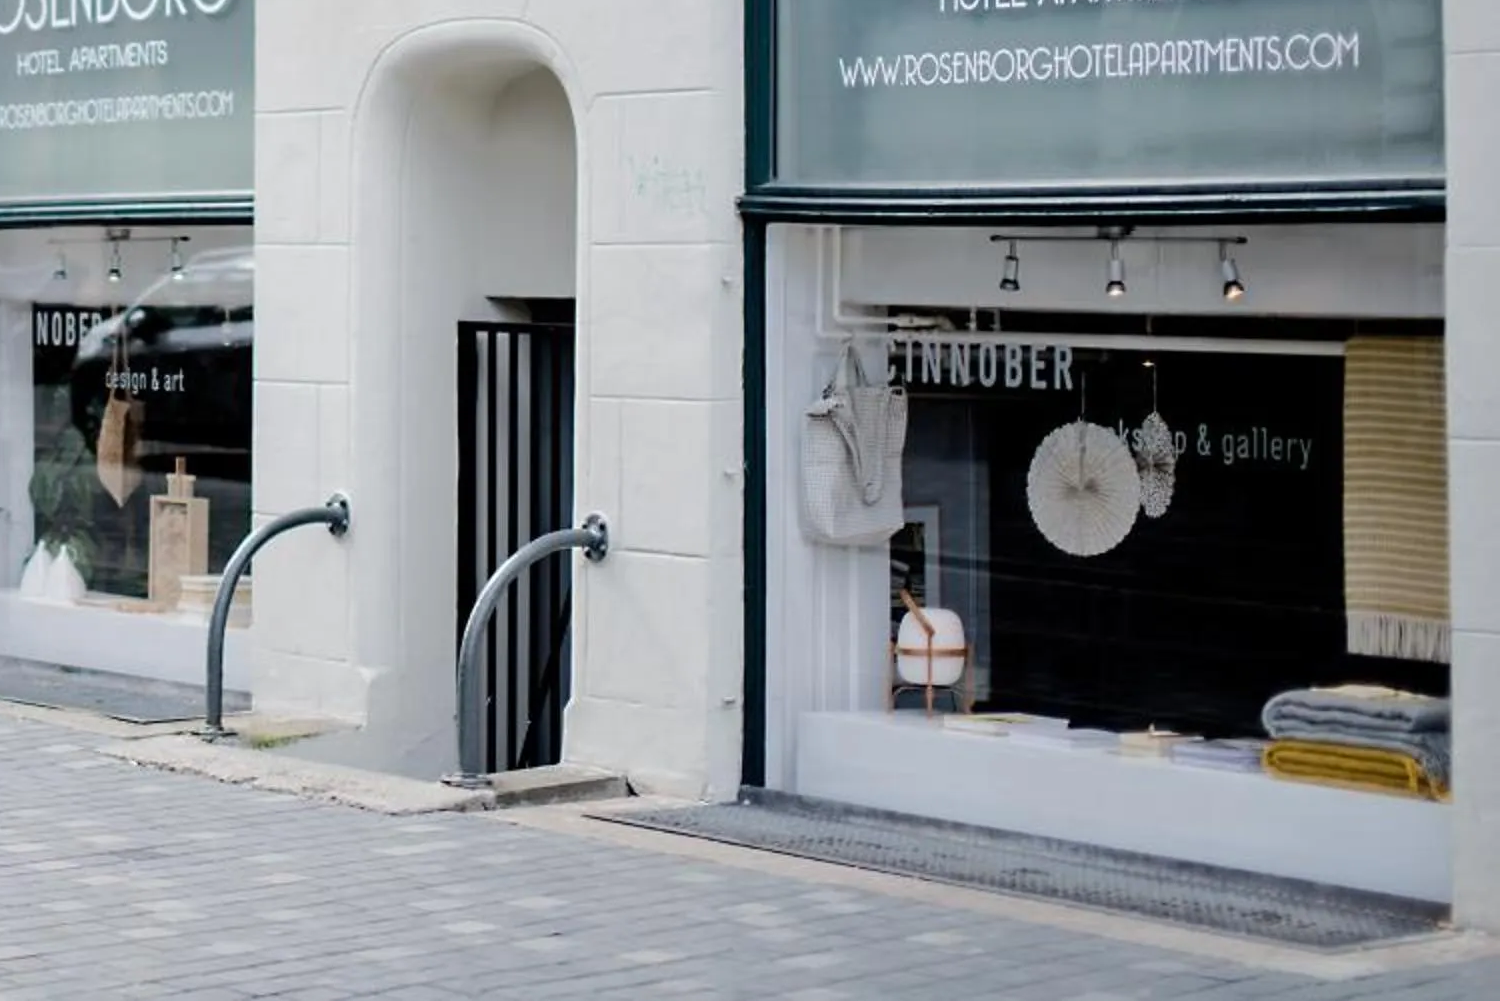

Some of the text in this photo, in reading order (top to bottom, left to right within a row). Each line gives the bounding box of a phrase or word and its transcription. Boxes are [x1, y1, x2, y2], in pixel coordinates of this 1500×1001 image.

[16, 40, 169, 76] HOTEL APARTMENTS
[839, 33, 1359, 88] WWW.ROSENBORGHOTELAPARTMENTS.COM
[151, 367, 161, 391] &
[163, 367, 185, 392] art
[1197, 423, 1211, 456] &
[1221, 426, 1312, 469] gallery
